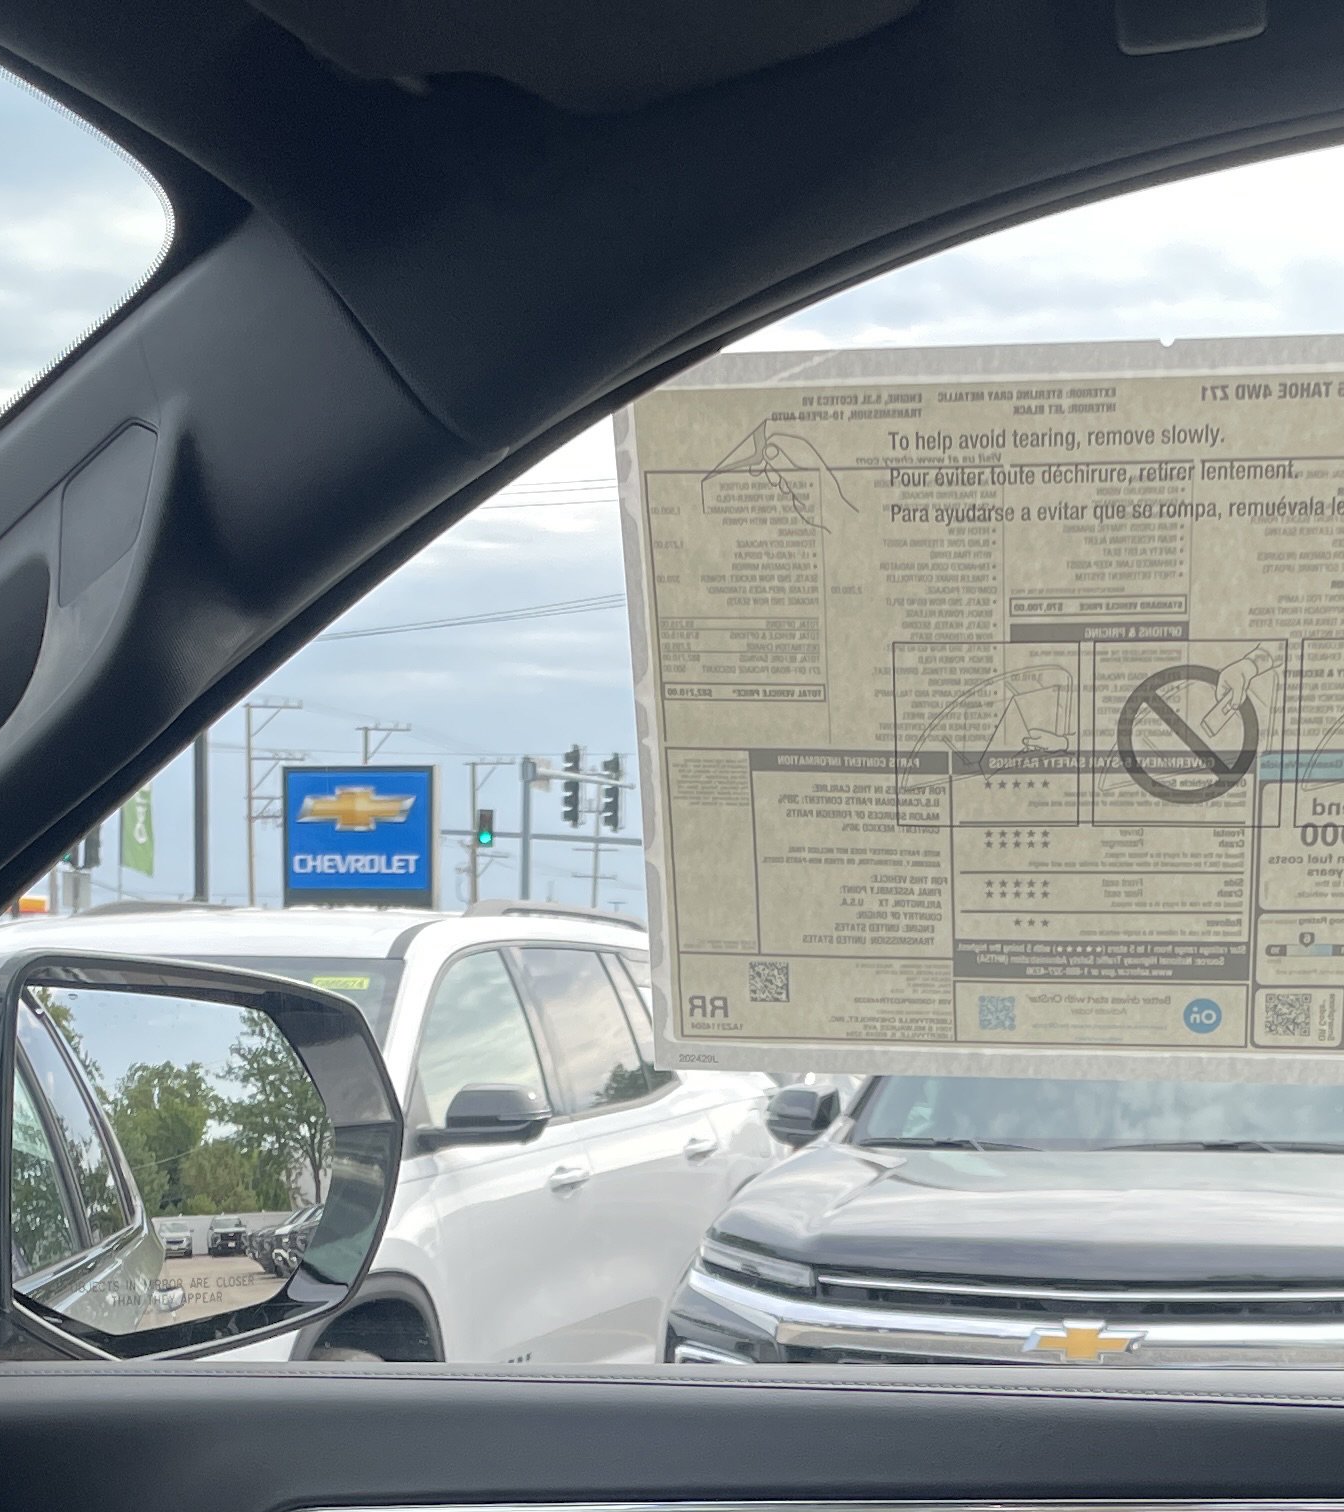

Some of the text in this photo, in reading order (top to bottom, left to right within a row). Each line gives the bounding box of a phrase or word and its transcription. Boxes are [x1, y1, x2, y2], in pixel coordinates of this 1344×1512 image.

[888, 424, 1224, 454] To help avoid tearing, remove slowly.
[889, 459, 1299, 487] Pour éviter toute déchirure, retirer lentement.
[890, 504, 928, 523] Para
[934, 502, 1014, 526] ayudarse
[1021, 506, 1031, 520] a
[1037, 499, 1087, 521] evitar
[1093, 503, 1126, 525] que
[1132, 504, 1153, 519] se
[1158, 501, 1222, 522] rompa,
[1228, 497, 1325, 517] remuévala
[293, 854, 420, 874] CHEVROLET
[126, 1280, 136, 1290] IN
[143, 1278, 183, 1290] MIRROR
[190, 1277, 208, 1288] ARE
[216, 1275, 255, 1287] CLOSER
[112, 1292, 222, 1306] THAN THEY APPEAR
